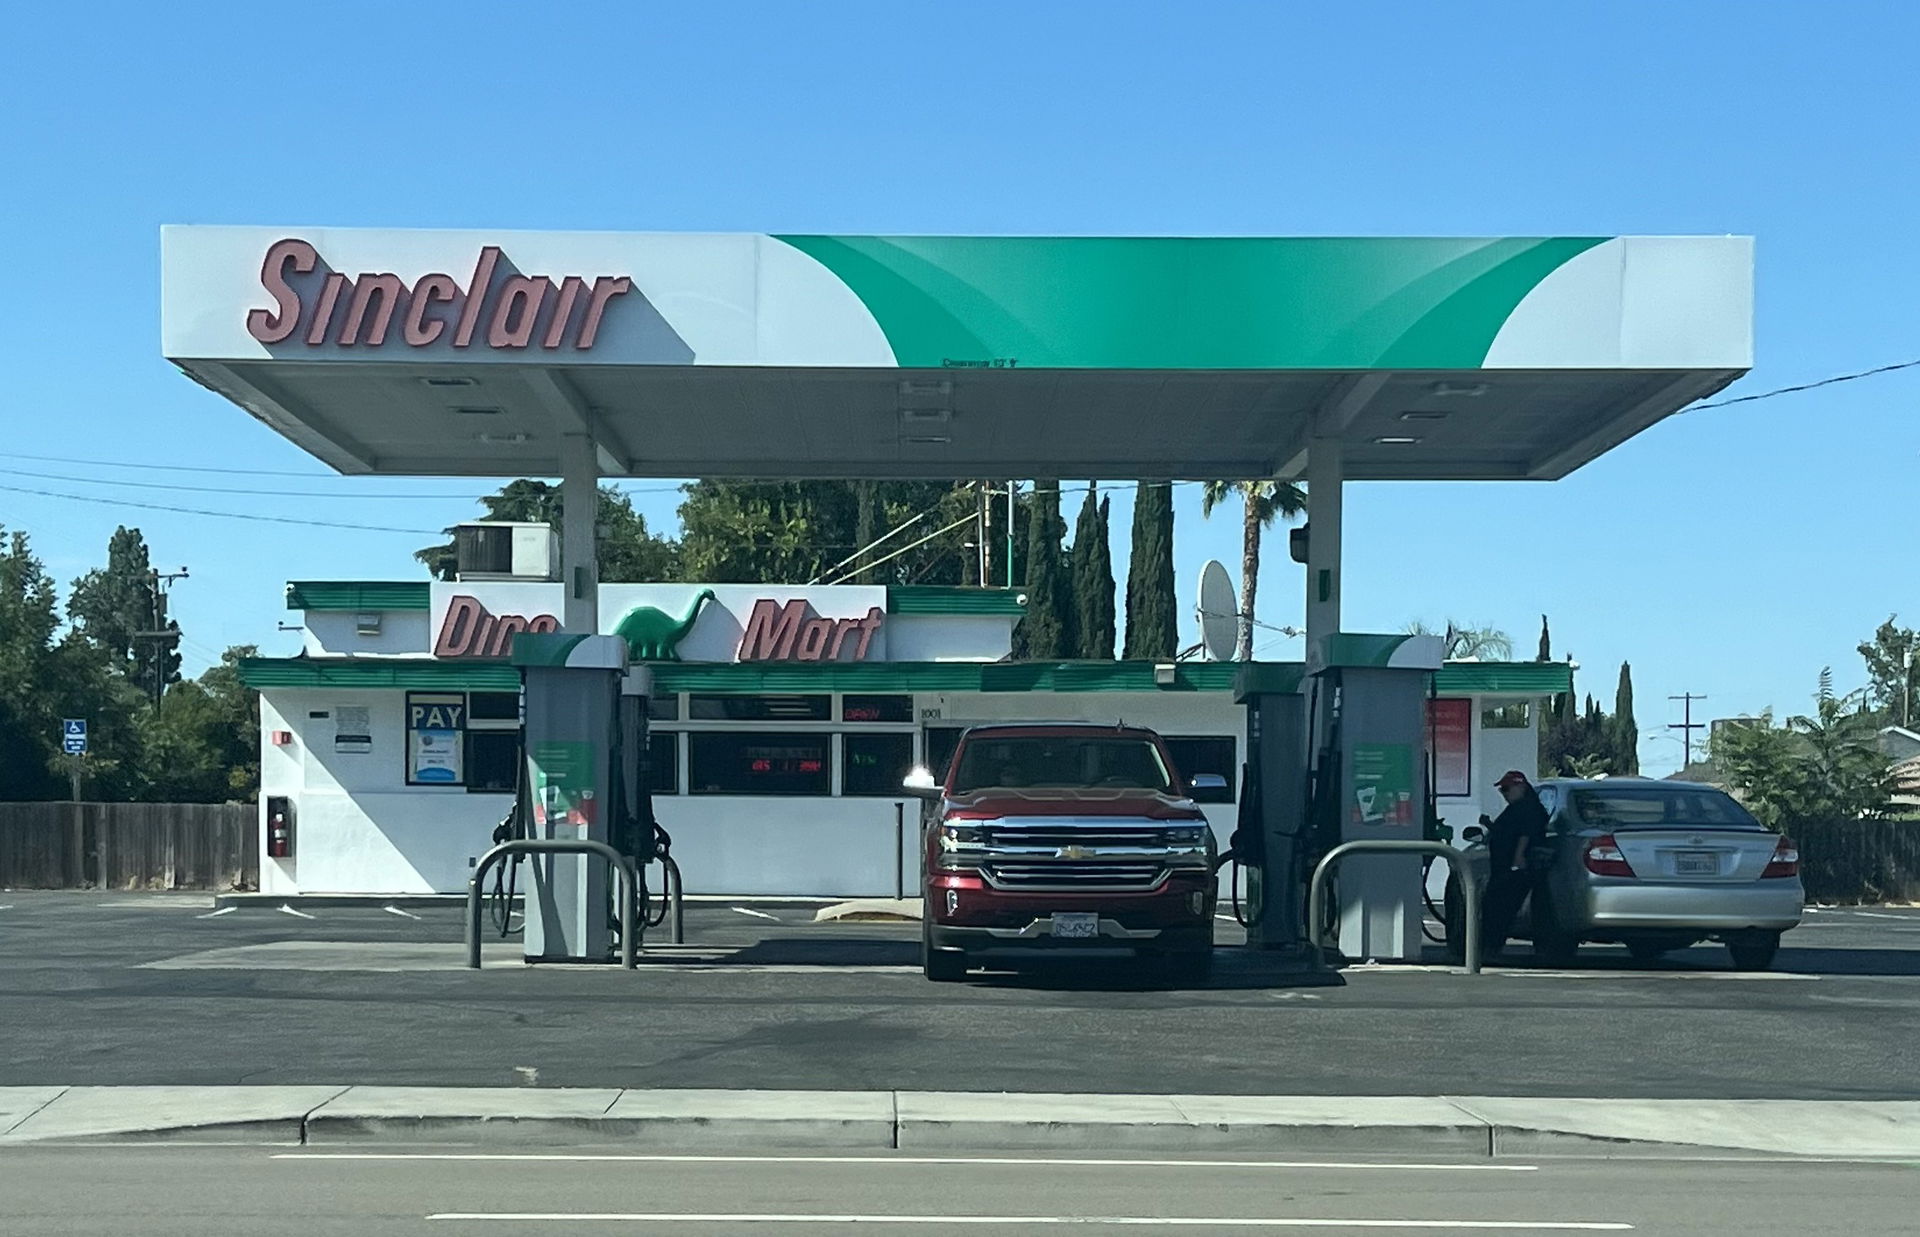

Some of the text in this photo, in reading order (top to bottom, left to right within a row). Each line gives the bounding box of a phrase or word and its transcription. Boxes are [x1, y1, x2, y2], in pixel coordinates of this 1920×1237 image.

[246, 238, 631, 350] Sinclair
[739, 598, 882, 662] Mart
[411, 706, 462, 728] PAY
